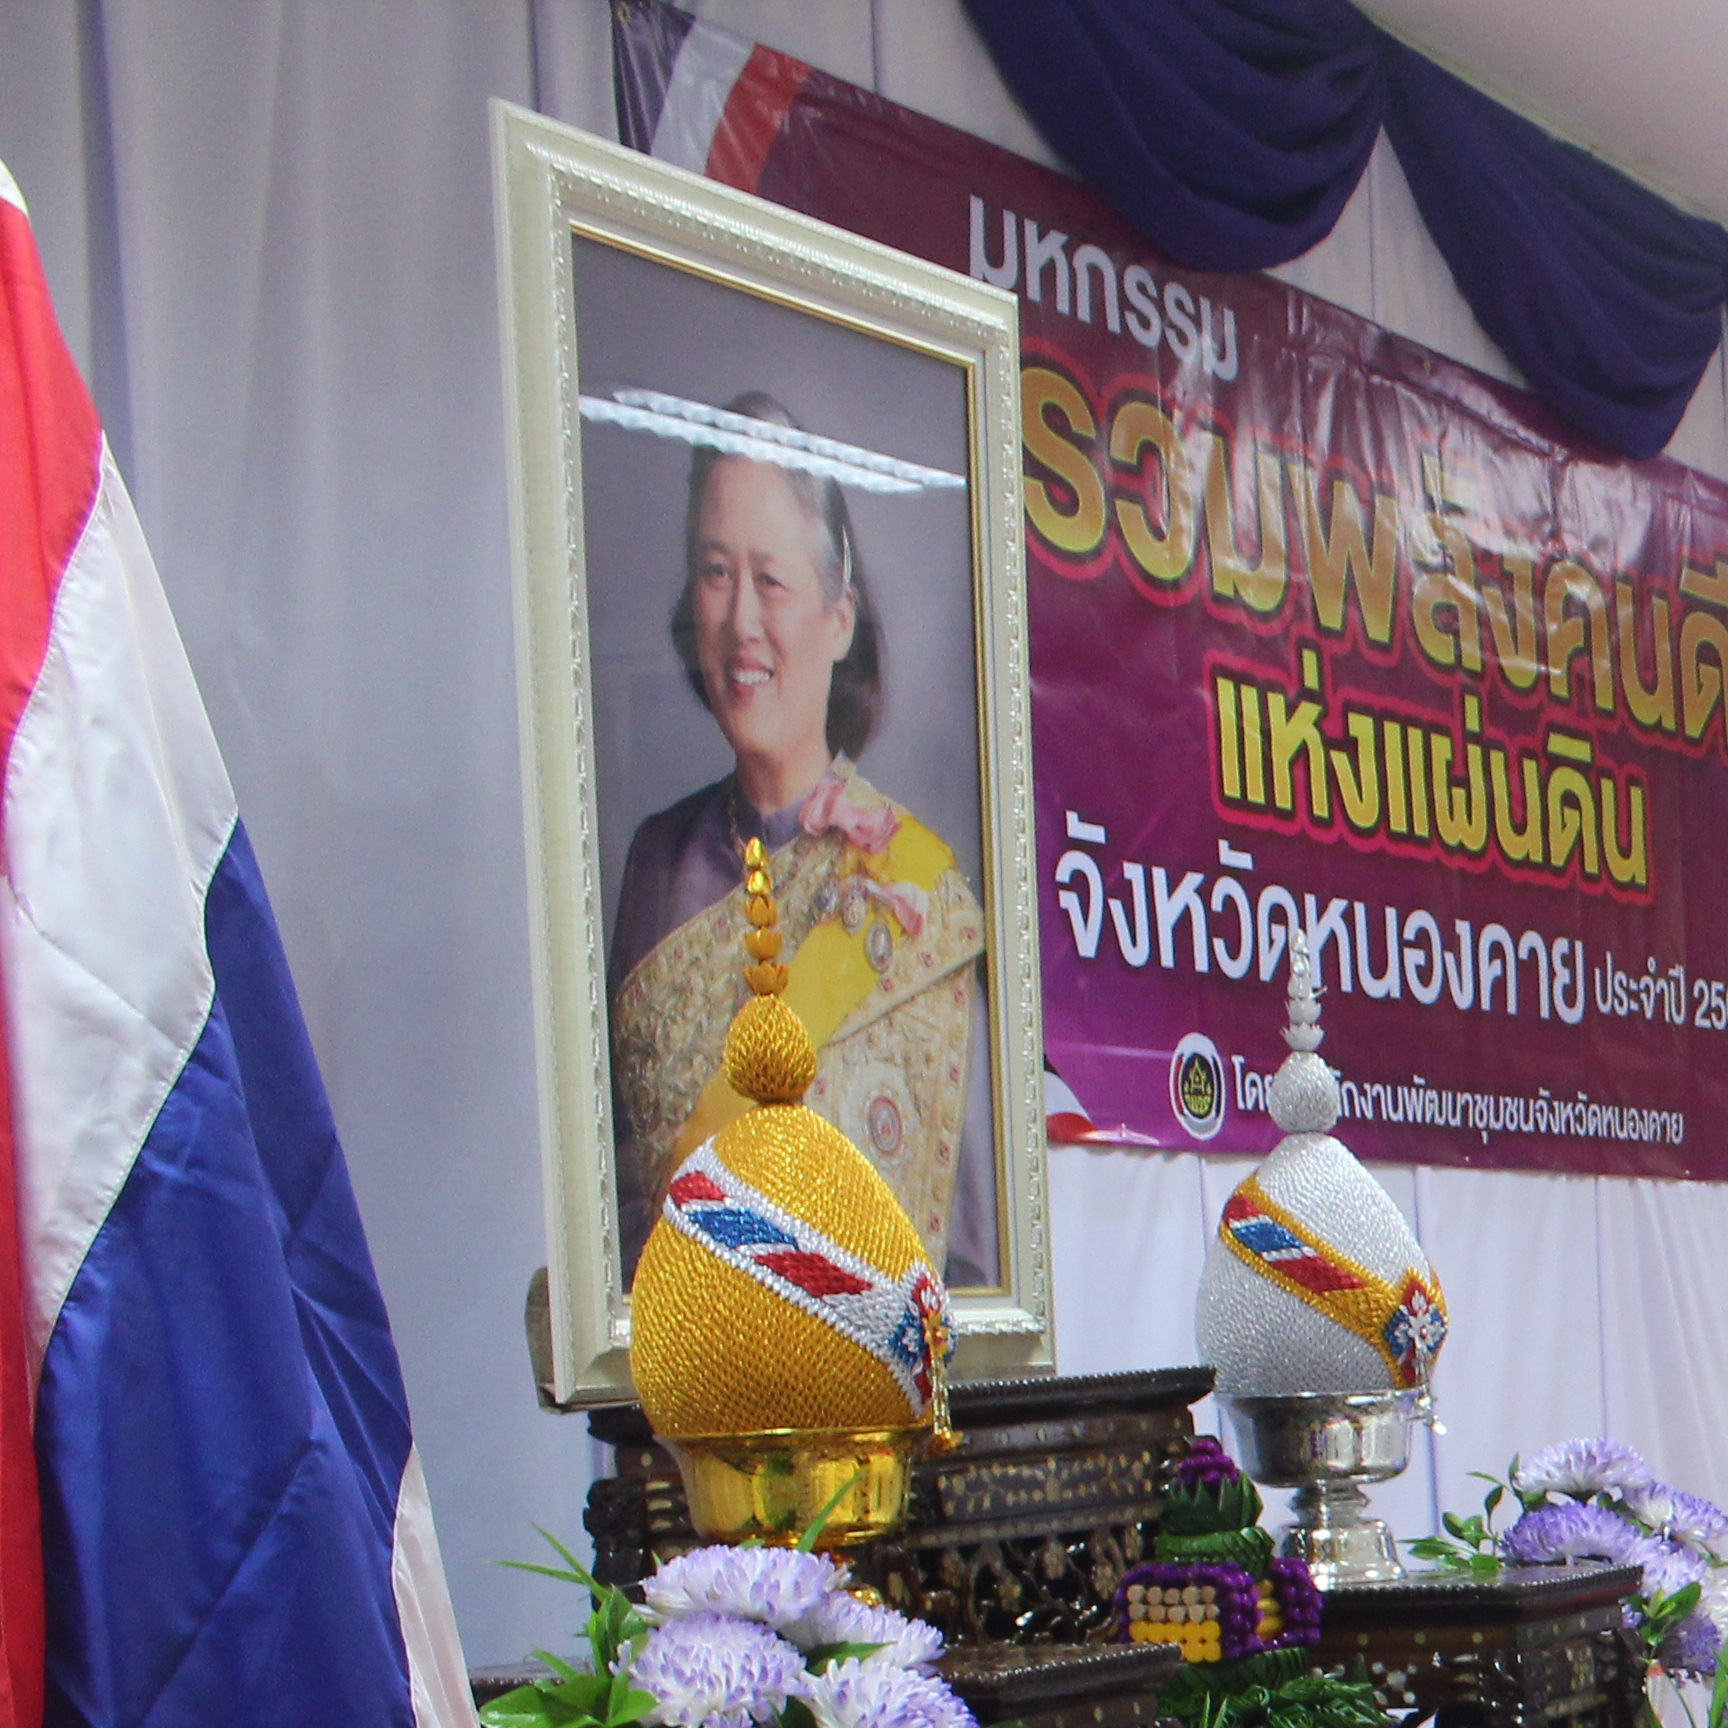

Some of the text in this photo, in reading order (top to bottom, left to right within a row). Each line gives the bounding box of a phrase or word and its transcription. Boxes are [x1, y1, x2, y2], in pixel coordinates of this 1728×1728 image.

[968, 194, 1239, 382] มหกรรม
[1215, 647, 1648, 887] แห่งแผ่นดิน
[1054, 809, 1586, 1025] จังหวัดหนองคาย
[1594, 950, 1686, 1026] ประจำปี
